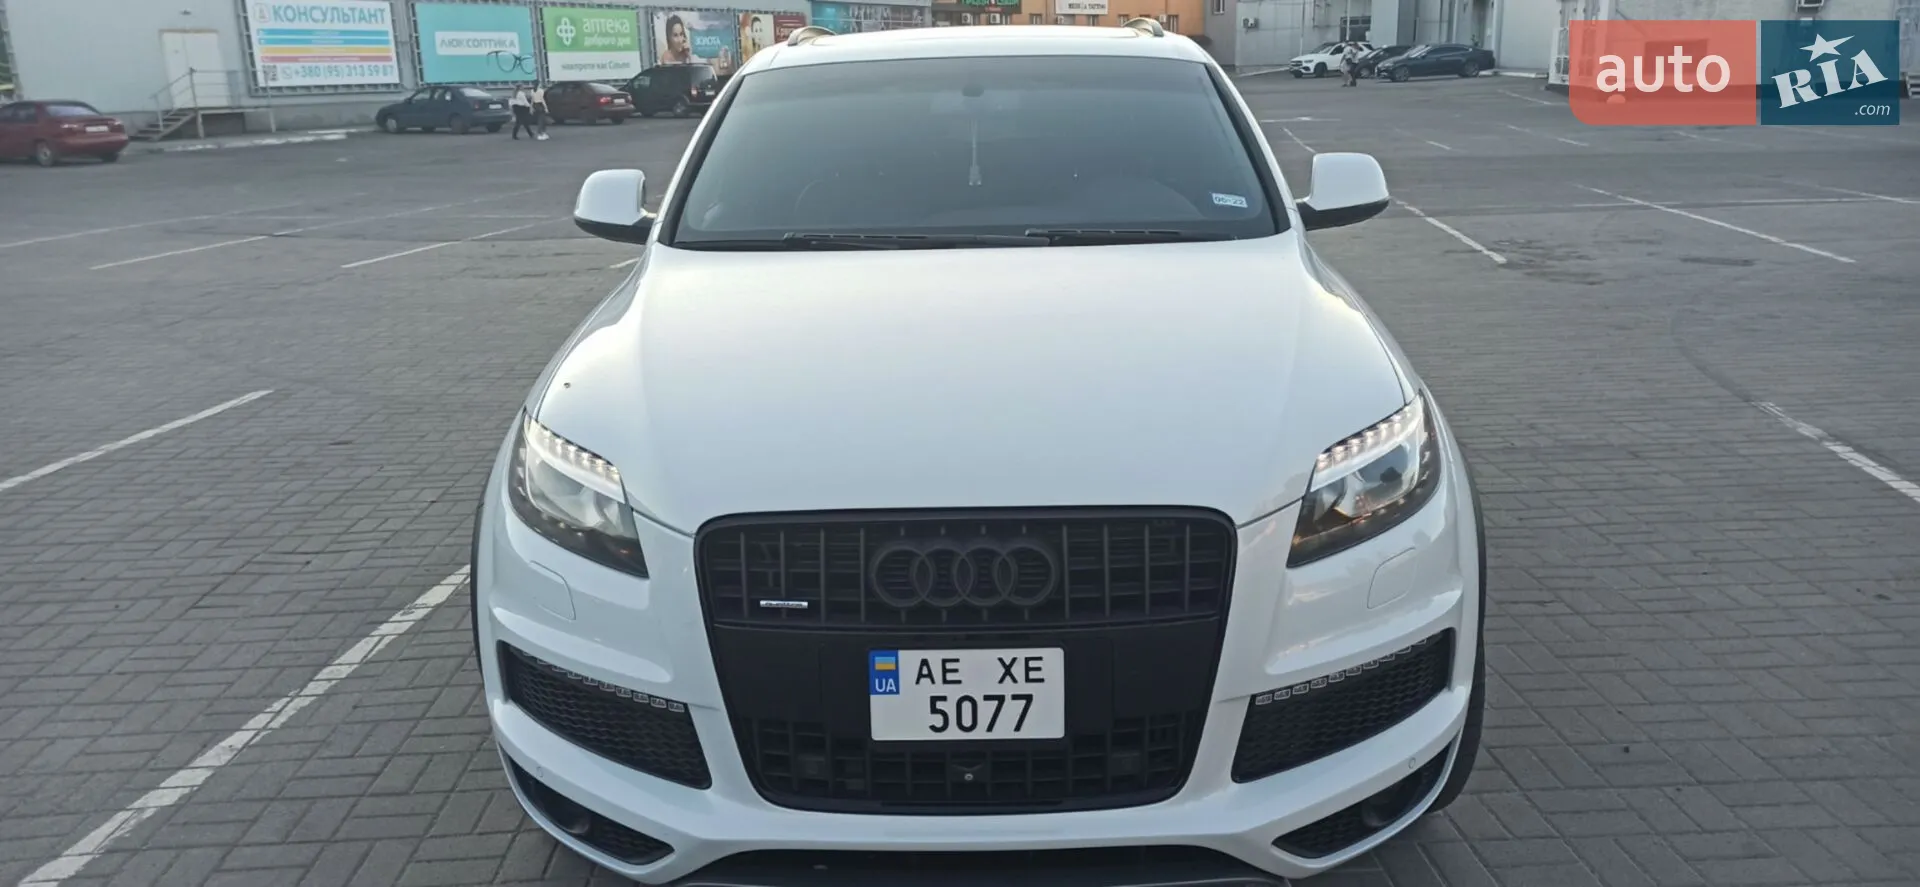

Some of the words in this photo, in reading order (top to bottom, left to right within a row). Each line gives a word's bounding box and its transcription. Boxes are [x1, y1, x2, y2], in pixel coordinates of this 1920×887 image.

[272, 5, 386, 24] КОНСУЛЬТАНТ
[583, 18, 630, 33] аптека
[439, 37, 516, 49] ЛЮКСОПТИКА
[293, 65, 321, 78] +380
[324, 65, 344, 79] (95)
[368, 64, 380, 77] 59
[915, 657, 962, 686] AE
[998, 656, 1044, 684] XE
[875, 678, 896, 693] UA
[929, 693, 1034, 733] 5077
